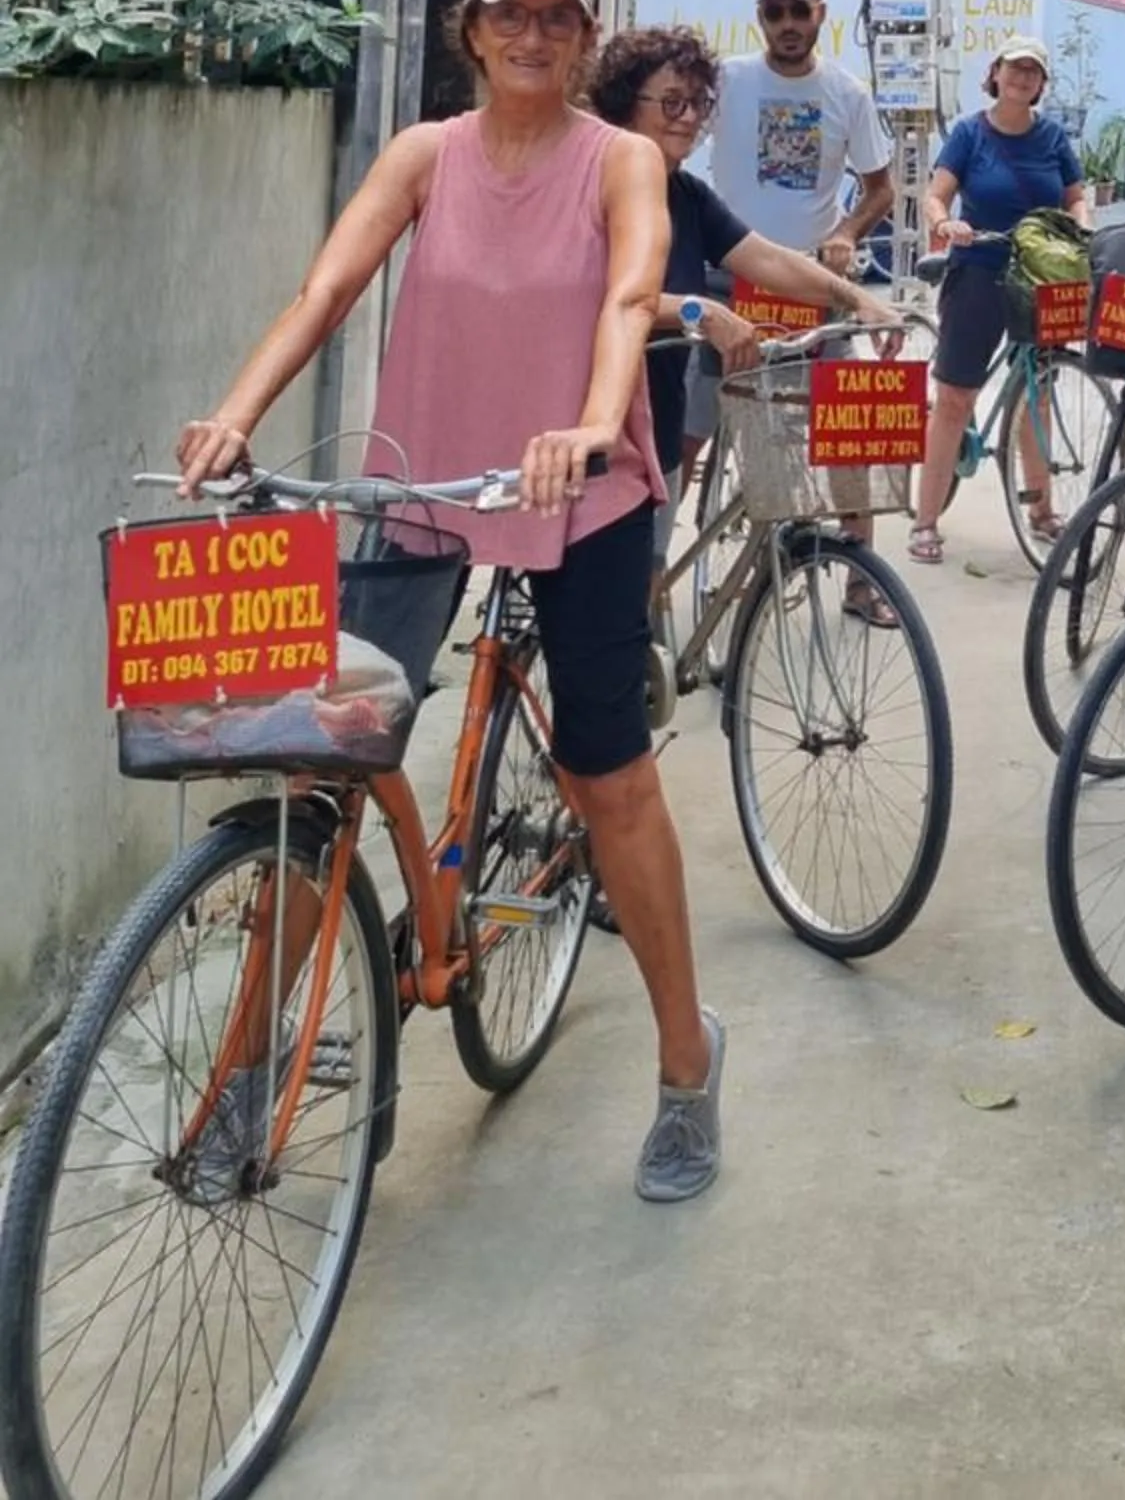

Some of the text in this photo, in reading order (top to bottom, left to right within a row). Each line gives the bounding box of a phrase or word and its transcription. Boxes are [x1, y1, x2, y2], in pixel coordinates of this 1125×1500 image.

[836, 369, 907, 392] TAM COC
[815, 404, 921, 430] FAMILY HOTEL
[227, 529, 289, 567] COC
[117, 584, 326, 647] FAMILY HOTEL
[163, 653, 207, 681] 094
[214, 647, 259, 675] 367
[266, 641, 329, 670] 7874
